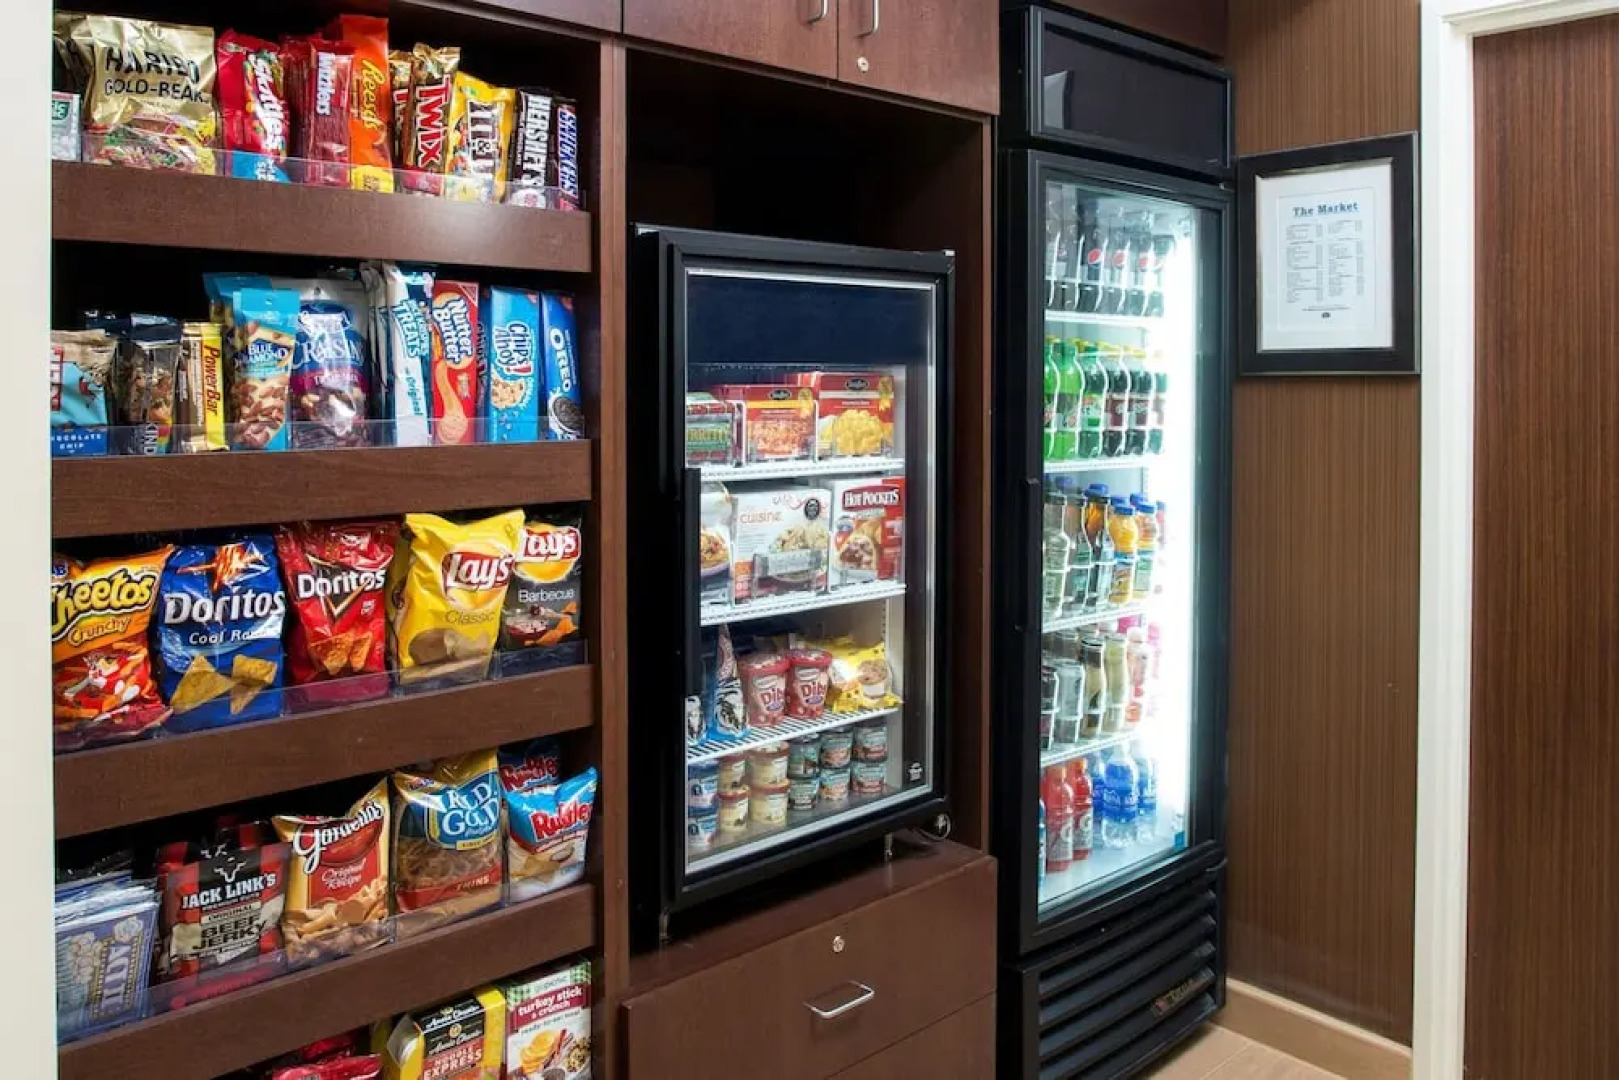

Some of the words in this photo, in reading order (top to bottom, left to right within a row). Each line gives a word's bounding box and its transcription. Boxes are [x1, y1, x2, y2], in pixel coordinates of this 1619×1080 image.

[416, 74, 451, 168] TWIX
[522, 94, 552, 188] HERSHEY'S
[558, 109, 578, 199] SNICKERS
[1293, 206, 1314, 217] The
[1317, 201, 1358, 215] Market
[395, 301, 421, 358] TREATS
[434, 308, 461, 364] Butter
[448, 298, 473, 357] Nutter
[550, 328, 571, 392] OREO
[203, 345, 221, 416] PowerBar
[298, 569, 386, 598] Doritos
[446, 552, 510, 589] Lay's
[164, 588, 285, 625] Doritos
[518, 587, 575, 602] Barbecue
[68, 617, 131, 647] Crunchy
[446, 610, 494, 624] Classic
[189, 629, 225, 645] Cool
[182, 886, 222, 909] JACK
[225, 873, 277, 899] LINK'S
[192, 920, 267, 949] JERKY
[201, 916, 261, 937] BEEF
[518, 995, 555, 1016] turkey
[556, 985, 582, 1002] stick
[538, 1000, 571, 1016] crunch
[423, 1048, 482, 1080] EXPRESS
